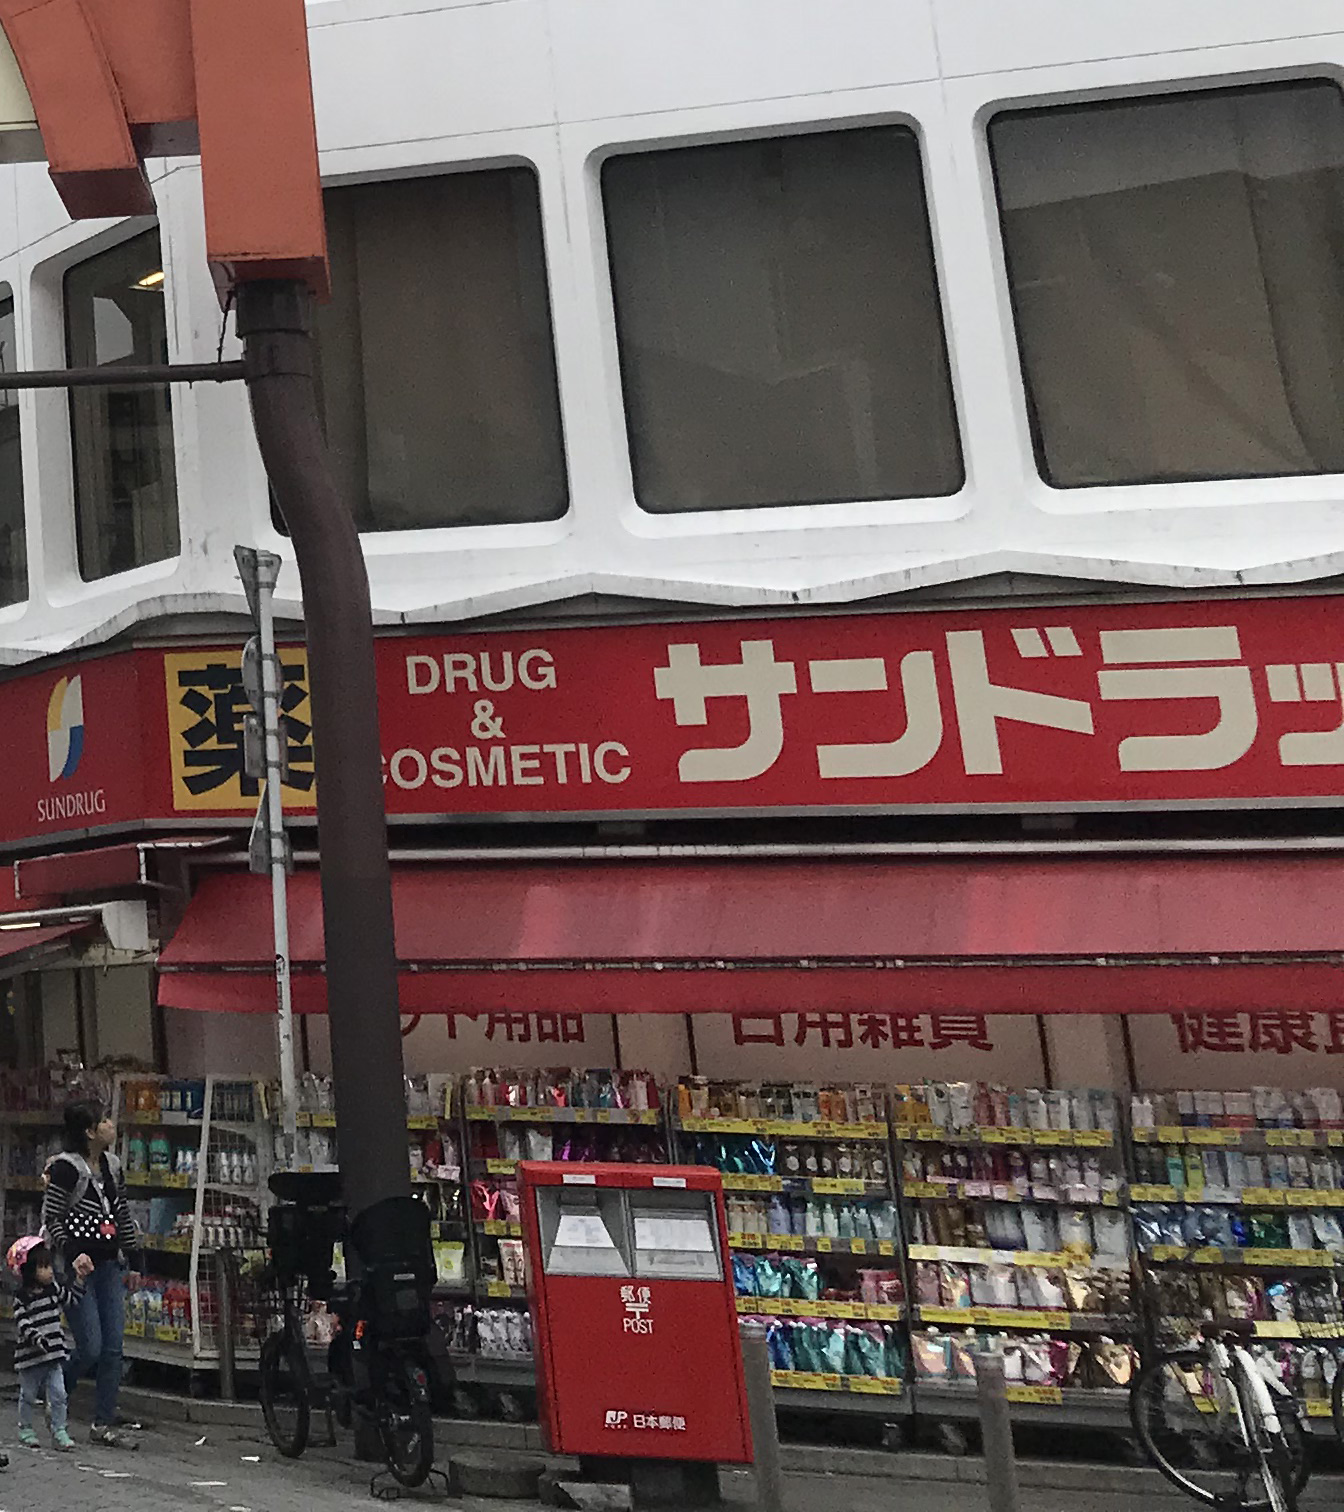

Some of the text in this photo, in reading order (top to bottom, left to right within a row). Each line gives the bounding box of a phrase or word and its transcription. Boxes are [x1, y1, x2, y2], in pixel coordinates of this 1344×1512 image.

[406, 648, 558, 695] DRUG
[178, 664, 316, 797] 薬
[470, 699, 506, 741] &
[379, 741, 633, 790] OSMETIC
[37, 789, 106, 822] SUNDRUG
[620, 1286, 651, 1304] 郵便
[623, 1318, 653, 1334] POST
[633, 1414, 686, 1430] 日本郵便
